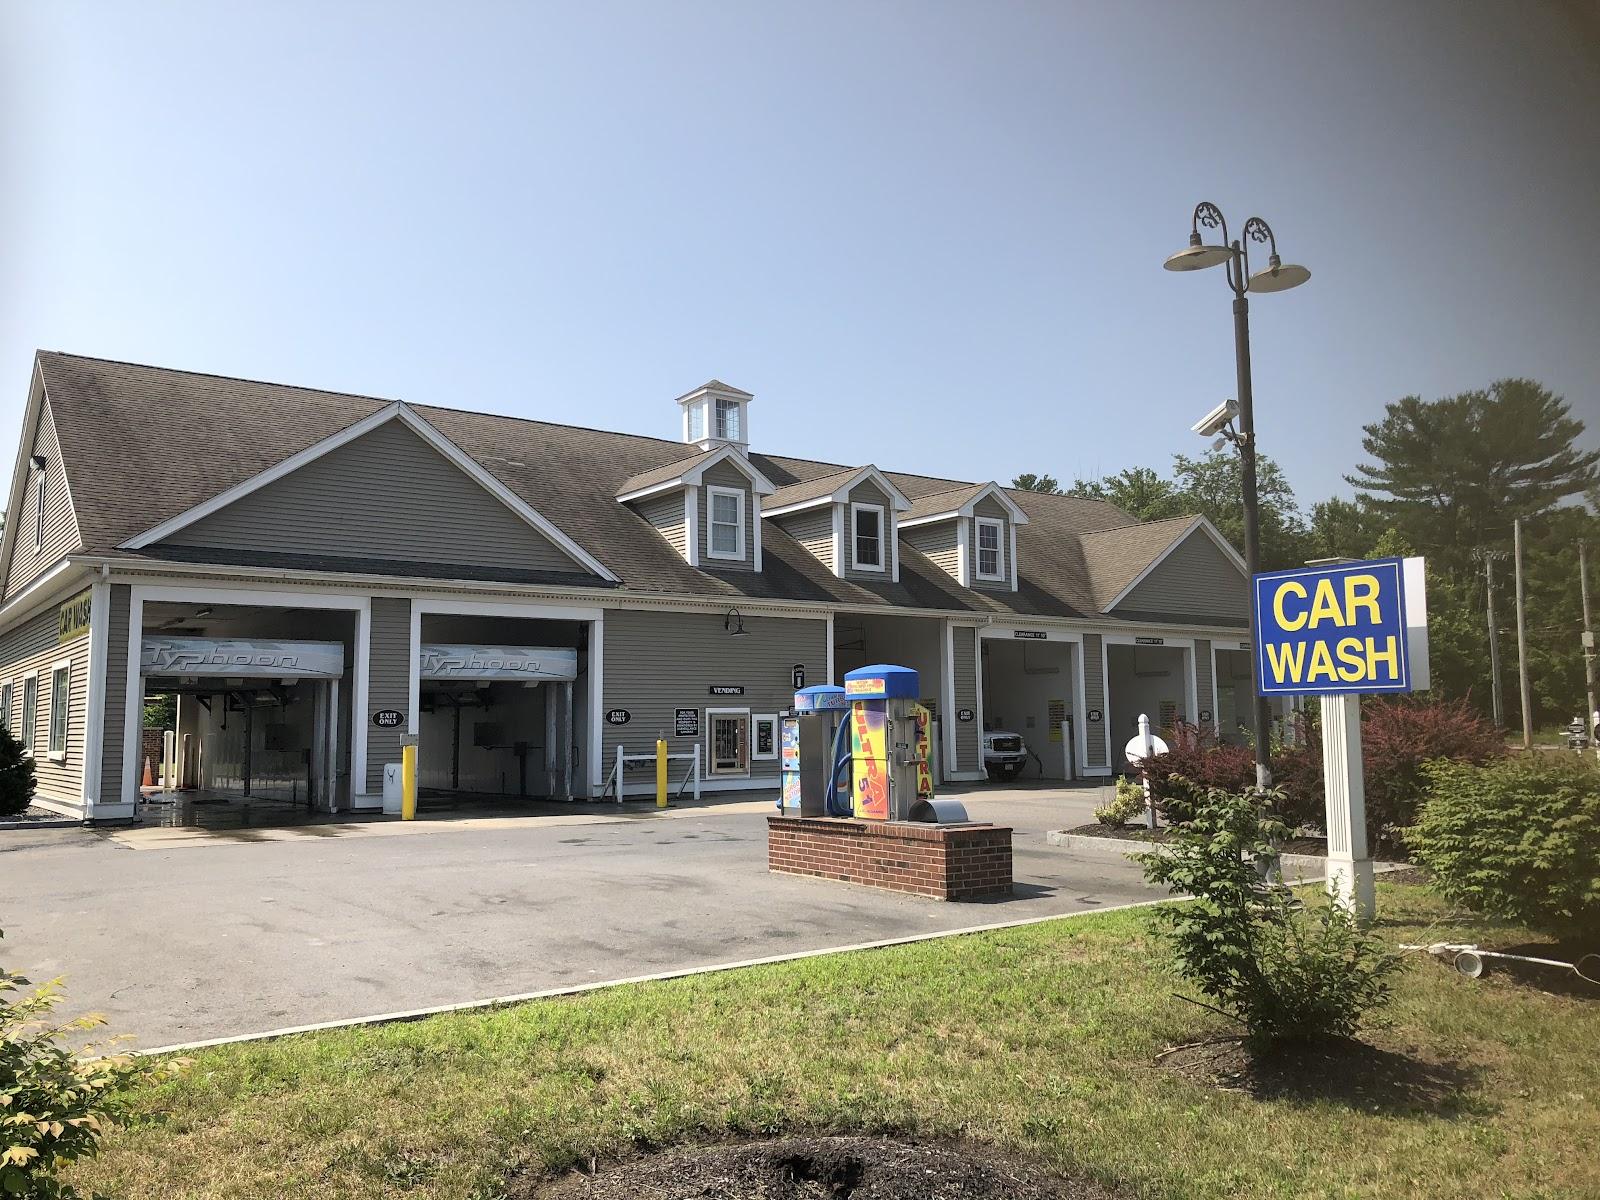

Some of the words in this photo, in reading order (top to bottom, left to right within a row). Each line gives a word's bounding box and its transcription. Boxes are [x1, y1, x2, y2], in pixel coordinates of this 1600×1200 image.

[60, 607, 72, 635] CAR
[1273, 574, 1382, 632] CAR
[145, 645, 299, 670] Typhoon
[420, 654, 540, 674] Typhoon
[1265, 636, 1398, 684] WASH
[854, 701, 885, 806] ULTRA
